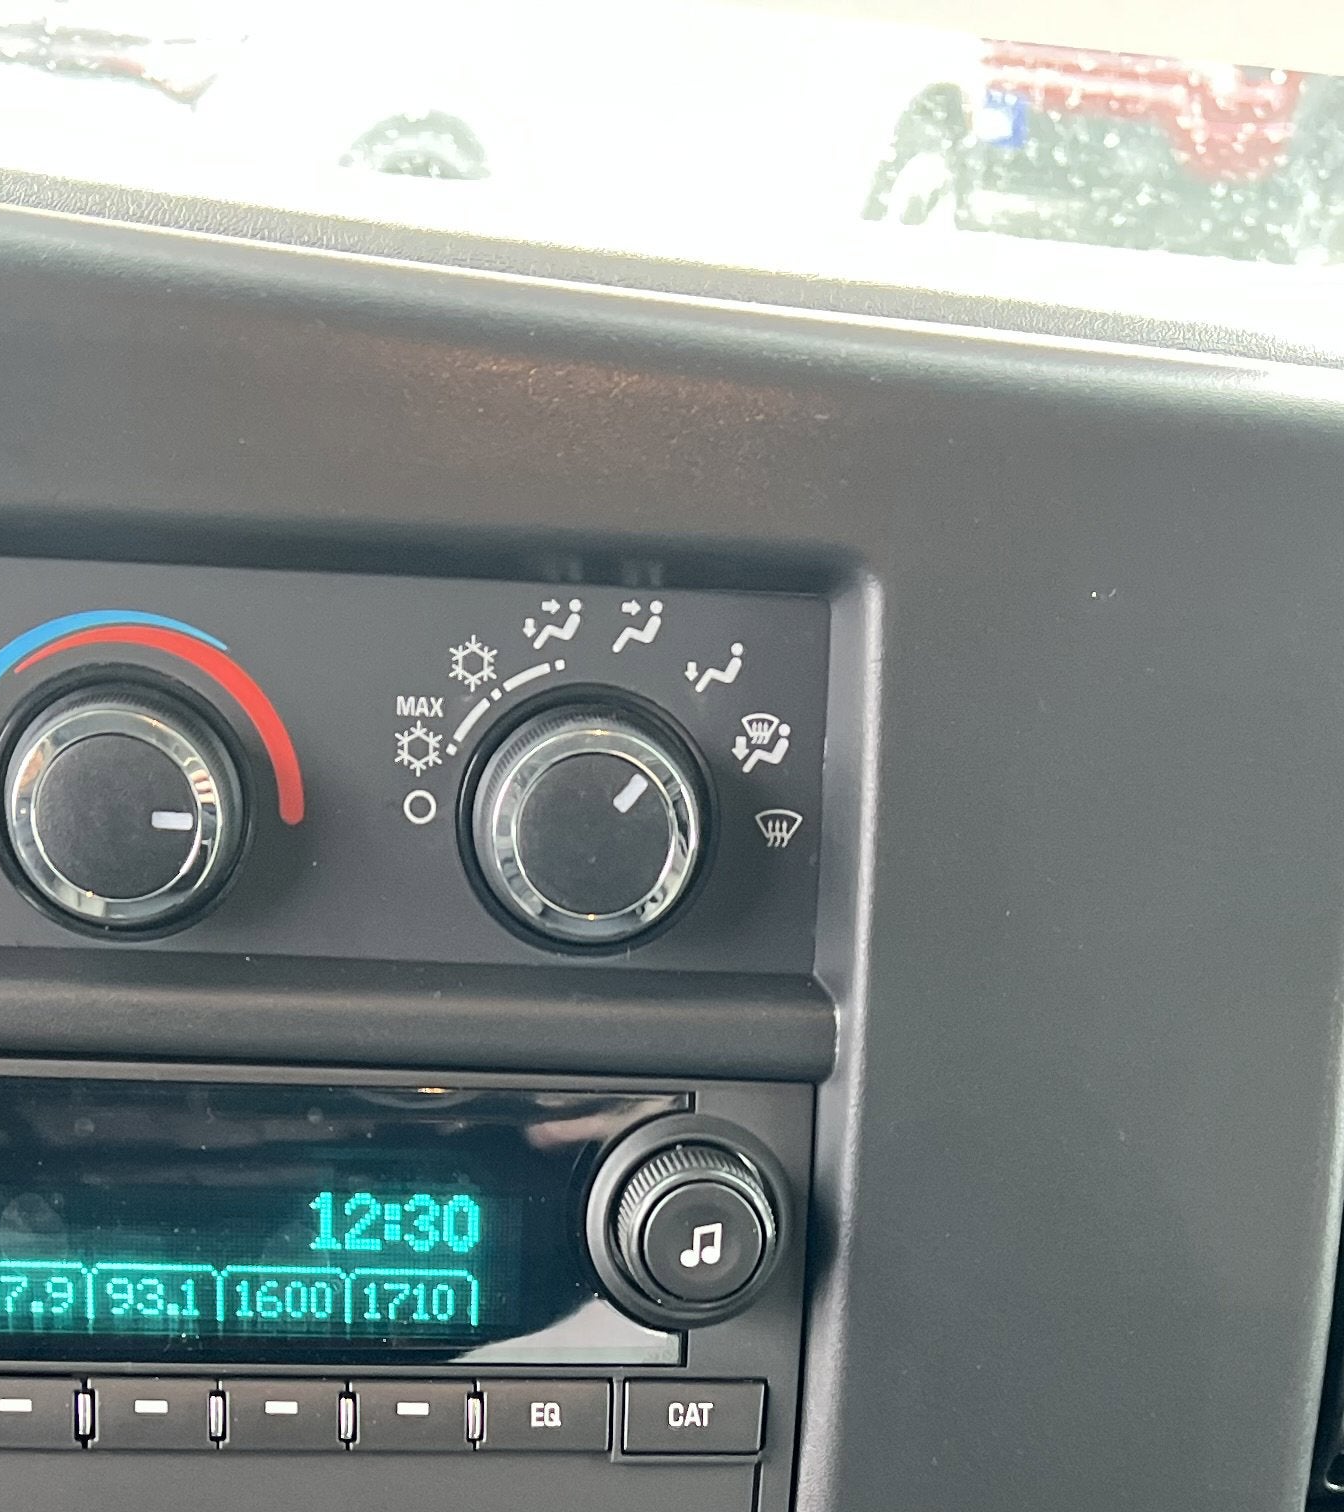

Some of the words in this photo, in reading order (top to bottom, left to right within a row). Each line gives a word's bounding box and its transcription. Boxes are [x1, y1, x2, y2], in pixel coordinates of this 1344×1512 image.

[396, 696, 444, 717] MAX
[309, 1191, 480, 1252] 12:30
[105, 1278, 199, 1315] 93.1
[236, 1281, 333, 1318] 1600
[363, 1281, 456, 1321] 1710
[531, 1402, 562, 1428] EQ
[668, 1403, 714, 1428] CAT
